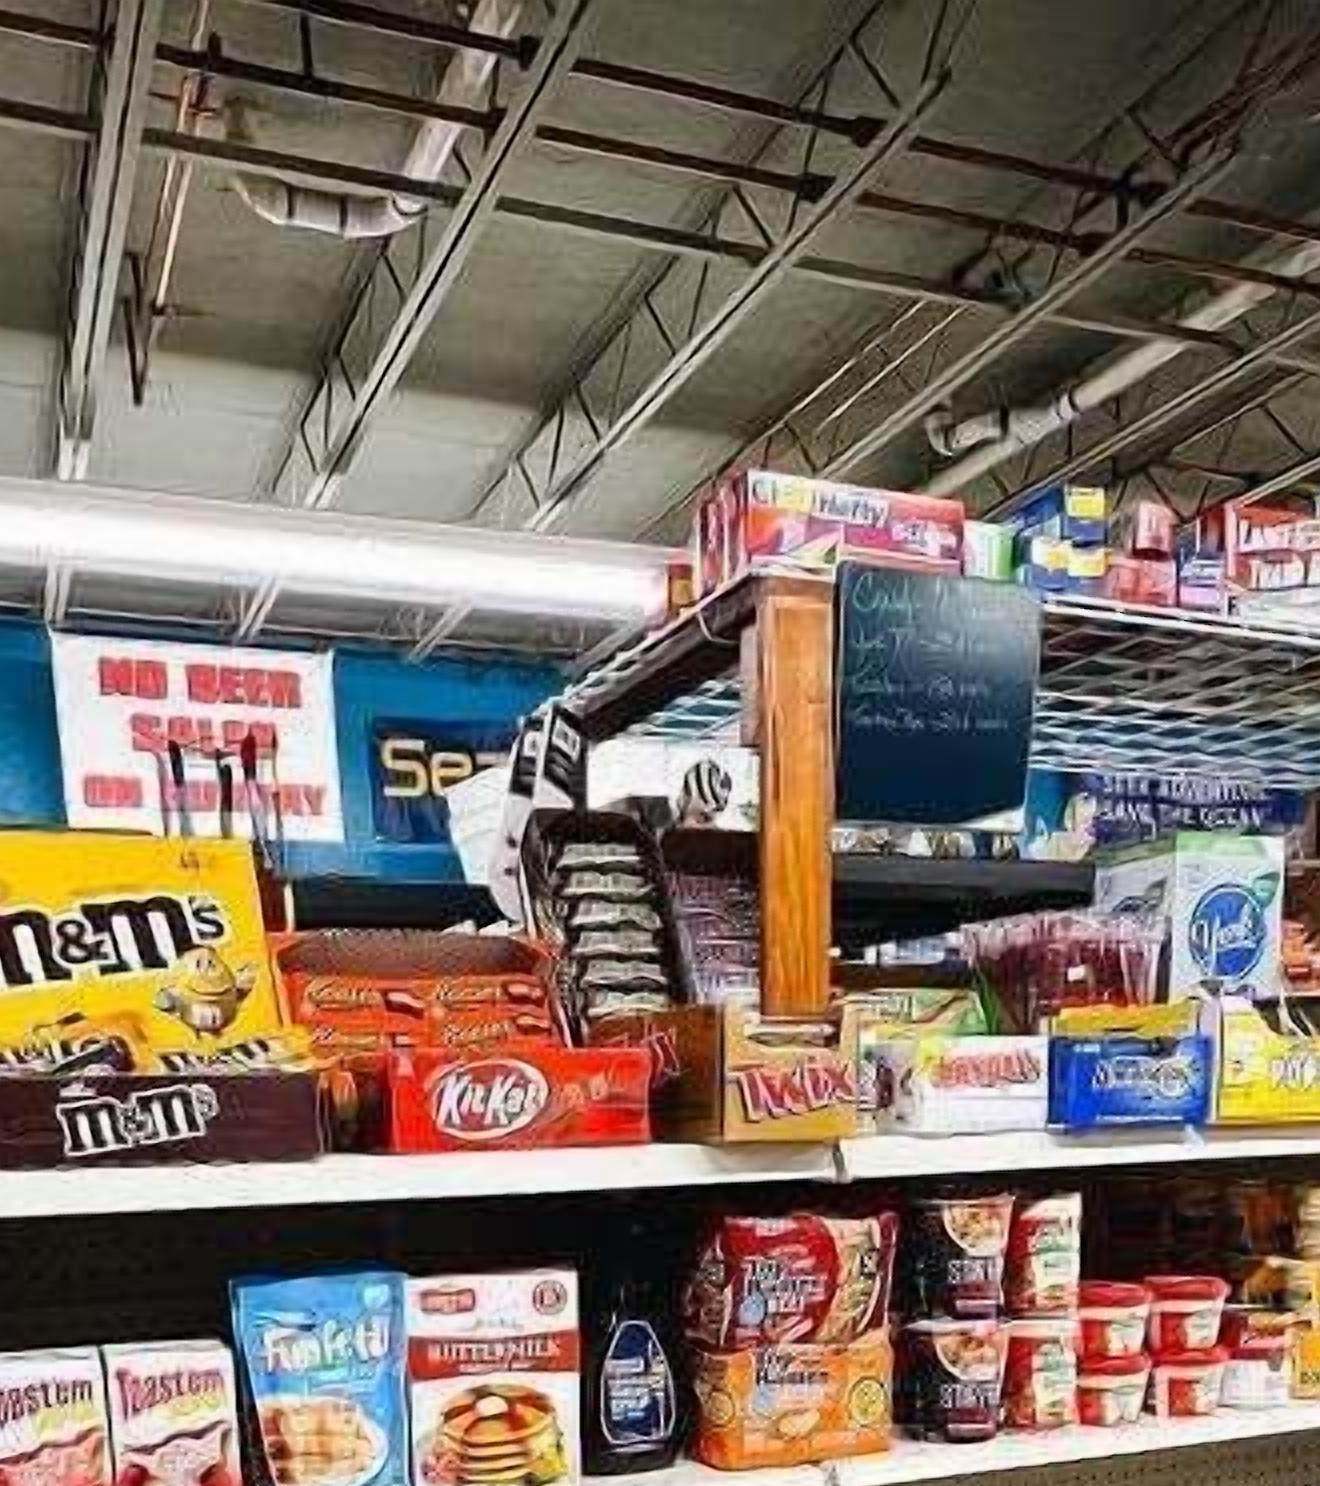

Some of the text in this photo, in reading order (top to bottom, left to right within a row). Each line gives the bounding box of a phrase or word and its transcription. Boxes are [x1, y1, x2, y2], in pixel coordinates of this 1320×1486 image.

[98, 657, 303, 709] NO BEER
[426, 1330, 562, 1364] BUTTERMILK
